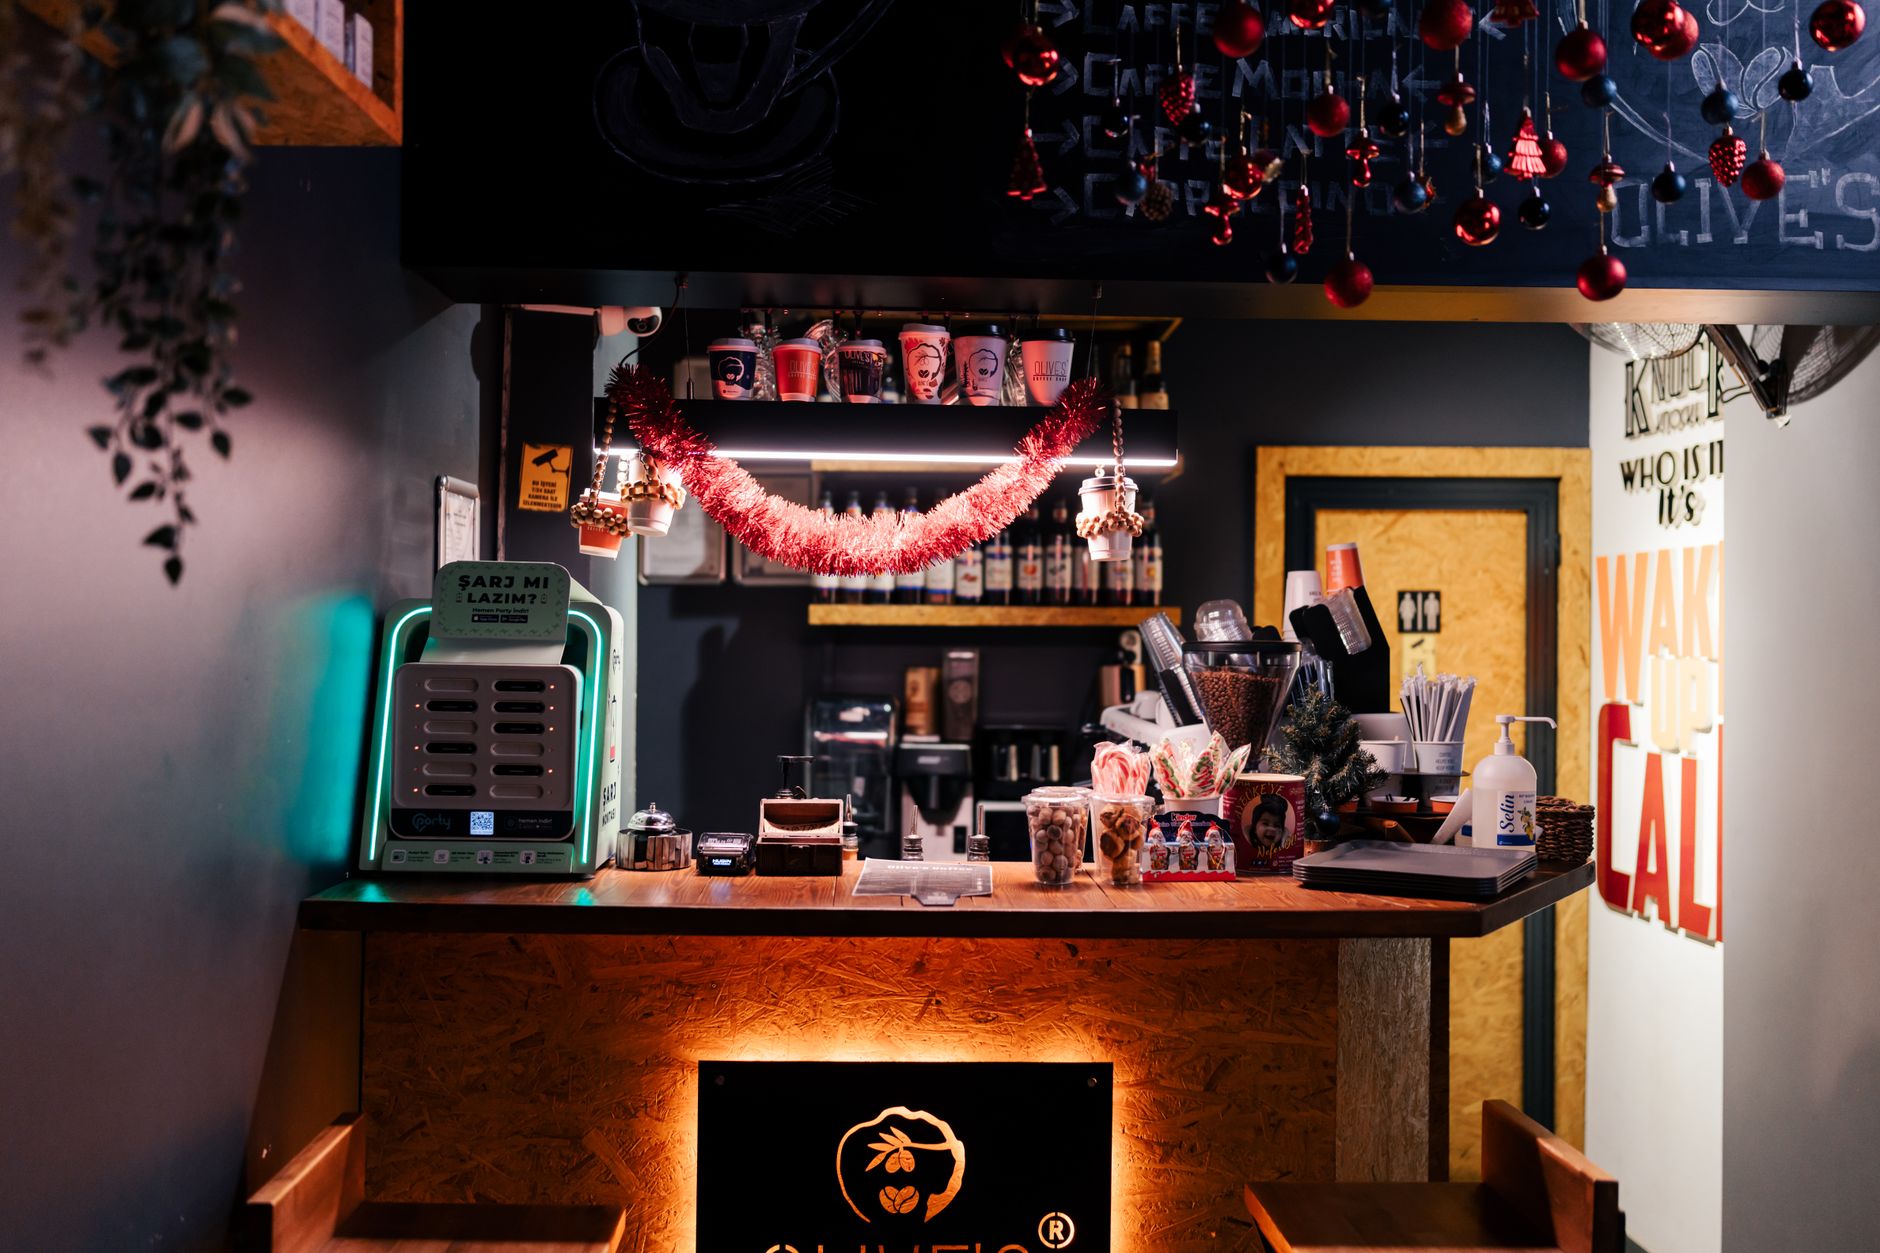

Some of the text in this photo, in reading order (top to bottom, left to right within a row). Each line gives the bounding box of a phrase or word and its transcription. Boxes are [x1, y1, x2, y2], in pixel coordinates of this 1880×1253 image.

[1620, 451, 1676, 490] WHO
[1684, 445, 1700, 480] IS
[458, 575, 549, 591] ŞARJ MI
[467, 593, 537, 604] LAZIM?
[1650, 657, 1711, 752] UP
[1500, 794, 1515, 833] Selin
